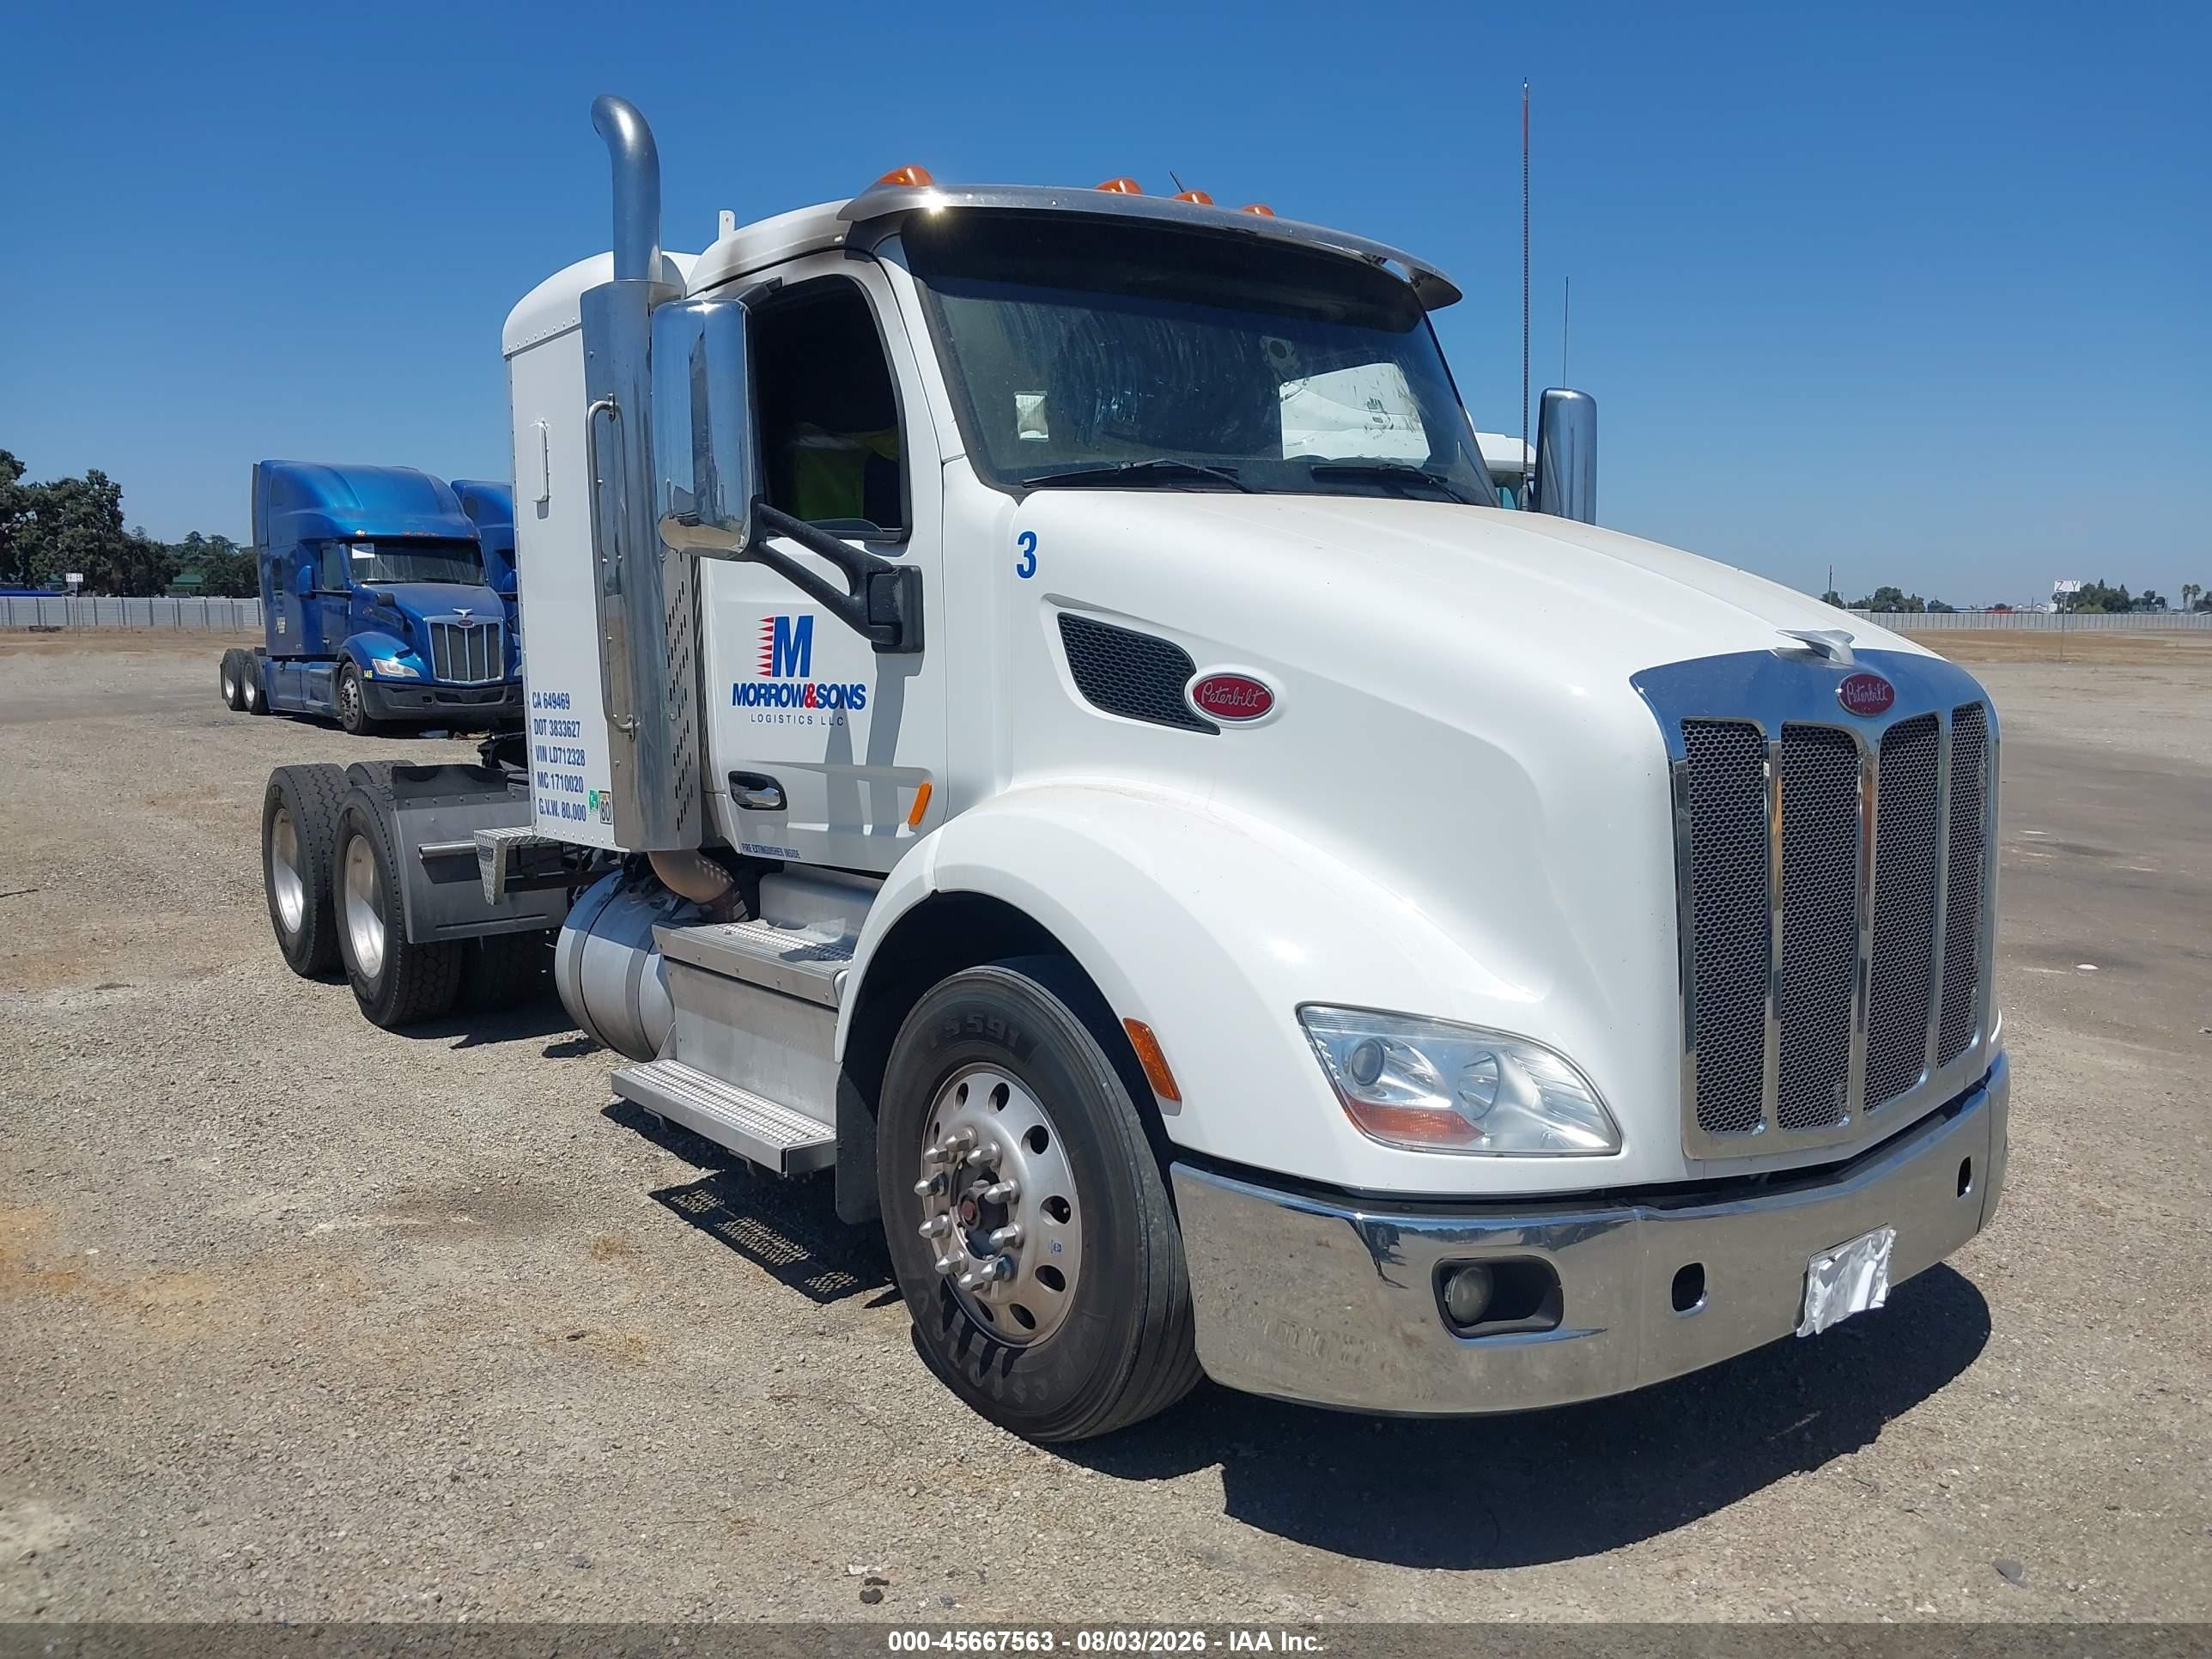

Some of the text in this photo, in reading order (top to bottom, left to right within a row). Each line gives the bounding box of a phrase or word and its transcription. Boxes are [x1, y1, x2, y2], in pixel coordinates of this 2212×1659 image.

[1016, 531, 1037, 579] 3
[2056, 580, 2078, 592] Z Y
[771, 615, 814, 678] M
[532, 691, 570, 710] CA 649469
[732, 683, 866, 711] MORROW&SONS
[1200, 681, 1265, 708] Peterbilt
[1846, 682, 1889, 705] Peterbilt
[533, 718, 580, 738] DOT 3833627
[750, 714, 844, 726] LOGISTICS LLC
[535, 744, 586, 767] VIN LD712328
[538, 771, 584, 793] MC 1710020
[538, 798, 586, 823] G.V.W. 80,000
